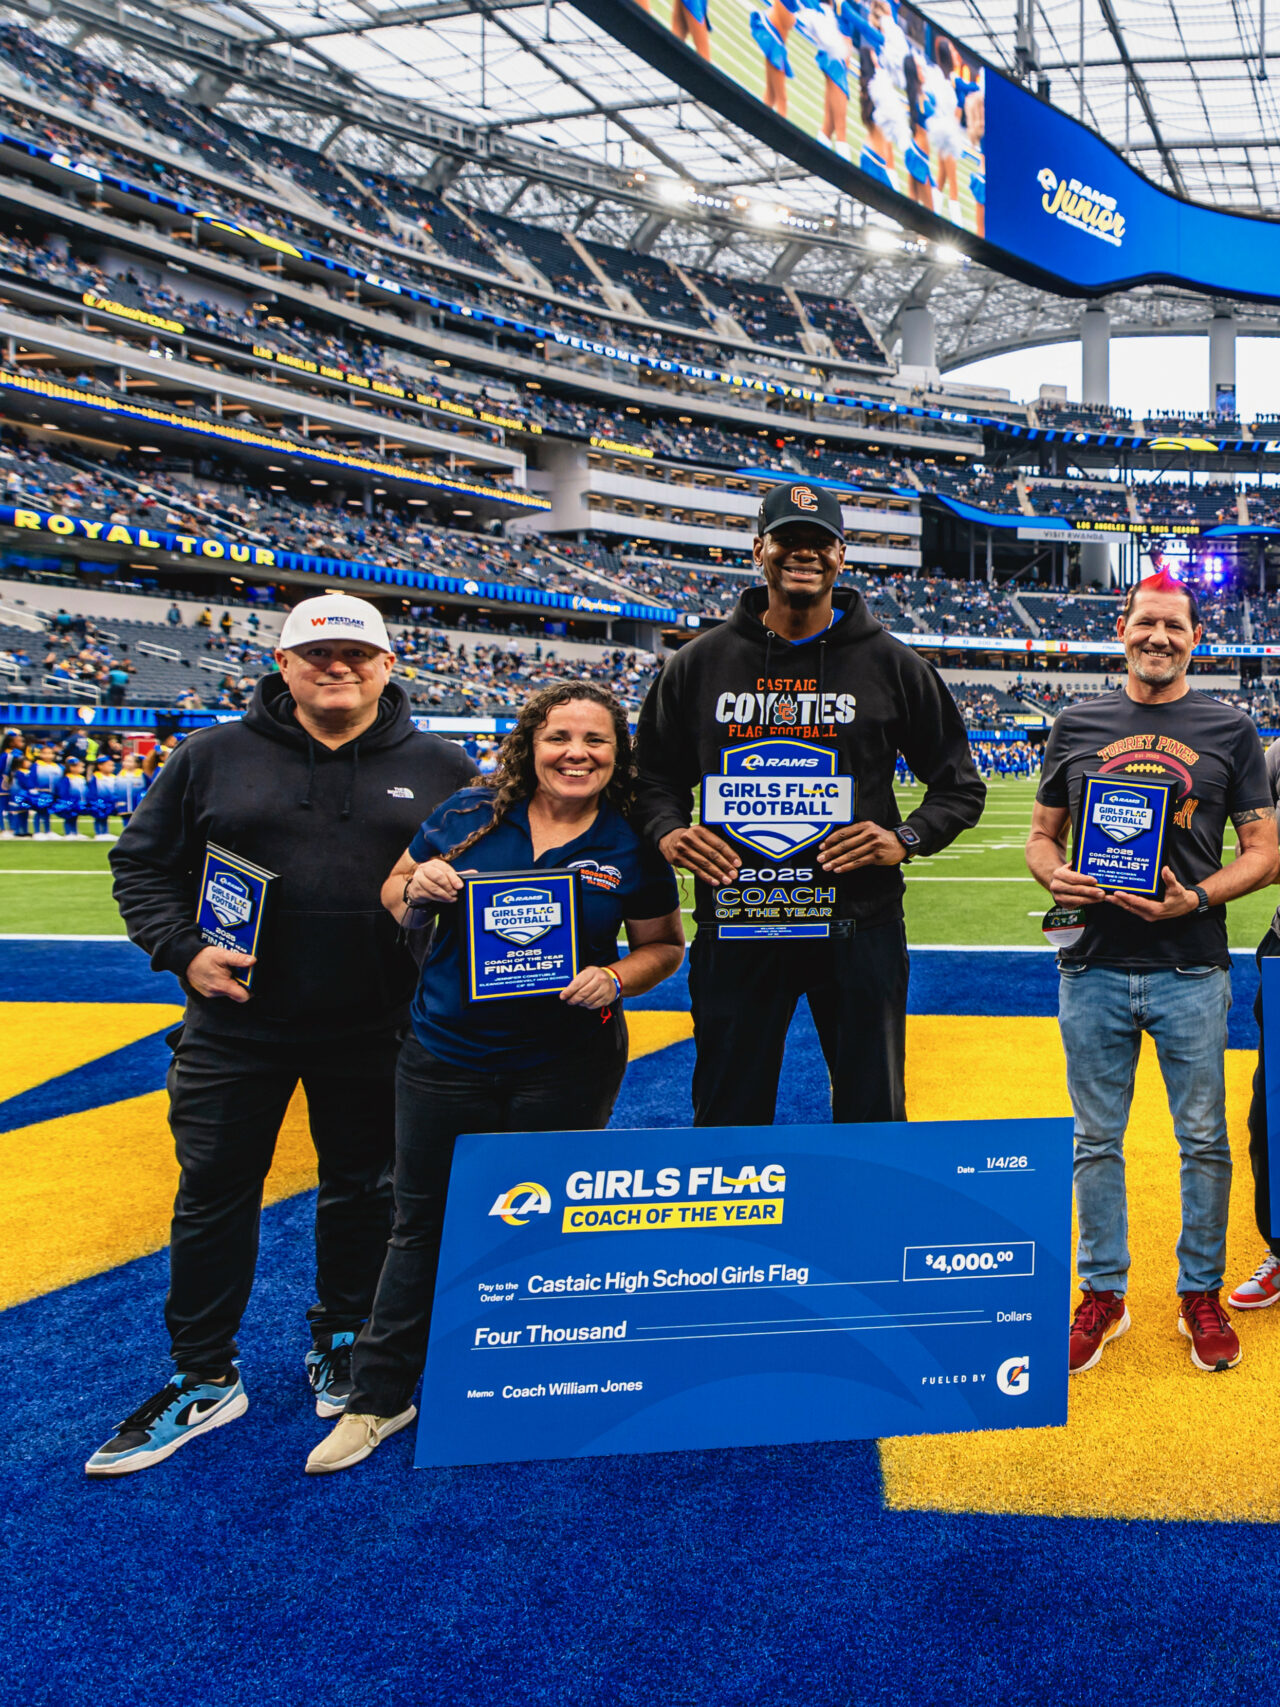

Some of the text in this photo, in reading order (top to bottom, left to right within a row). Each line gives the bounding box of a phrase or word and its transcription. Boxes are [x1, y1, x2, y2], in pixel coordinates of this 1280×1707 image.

[1068, 178, 1117, 211] RAMS
[1042, 179, 1126, 238] Junior
[554, 332, 825, 403] WELCOME TO THE ROYAL TOUR
[14, 508, 276, 567] ROYAL TOUR
[1043, 530, 1065, 538] VISIT
[327, 616, 365, 627] WESTLAKE
[757, 678, 817, 691] CASTAIC
[715, 691, 857, 725] COYTES
[728, 724, 838, 738] FLAG FOOTBALL
[1097, 734, 1200, 766] TORREY PINES
[766, 758, 819, 767] RAMS
[719, 782, 839, 798] GIRLS FLAG
[724, 801, 833, 816] FOOTBALL
[1099, 806, 1147, 818] GIRLS FLAG
[1100, 814, 1143, 825] FOOTBALL
[1088, 858, 1149, 871] FINALIST
[739, 868, 814, 882] 2025
[716, 887, 836, 905] COACH
[492, 906, 554, 917] GIRLS FLAG
[715, 907, 833, 918] OF THE YEAR
[495, 914, 551, 926] FOOTBALL
[506, 949, 542, 957] 2025
[484, 960, 564, 975] FINALIST
[957, 1156, 1028, 1174] Date 1/4/26
[565, 1164, 786, 1200] GIRLS FLAG
[570, 1204, 776, 1227] COACH OF THE YEAR
[527, 1264, 809, 1294] Castaic High School Girls Flag
[478, 1282, 519, 1293] Pay to the
[480, 1293, 514, 1302] Order of
[996, 1311, 1032, 1323] Dollars
[474, 1320, 628, 1346] Four Thousand
[922, 1374, 986, 1385] FUELED BY
[996, 1356, 1029, 1395] G
[467, 1379, 643, 1399] Memo Coach William Jones
